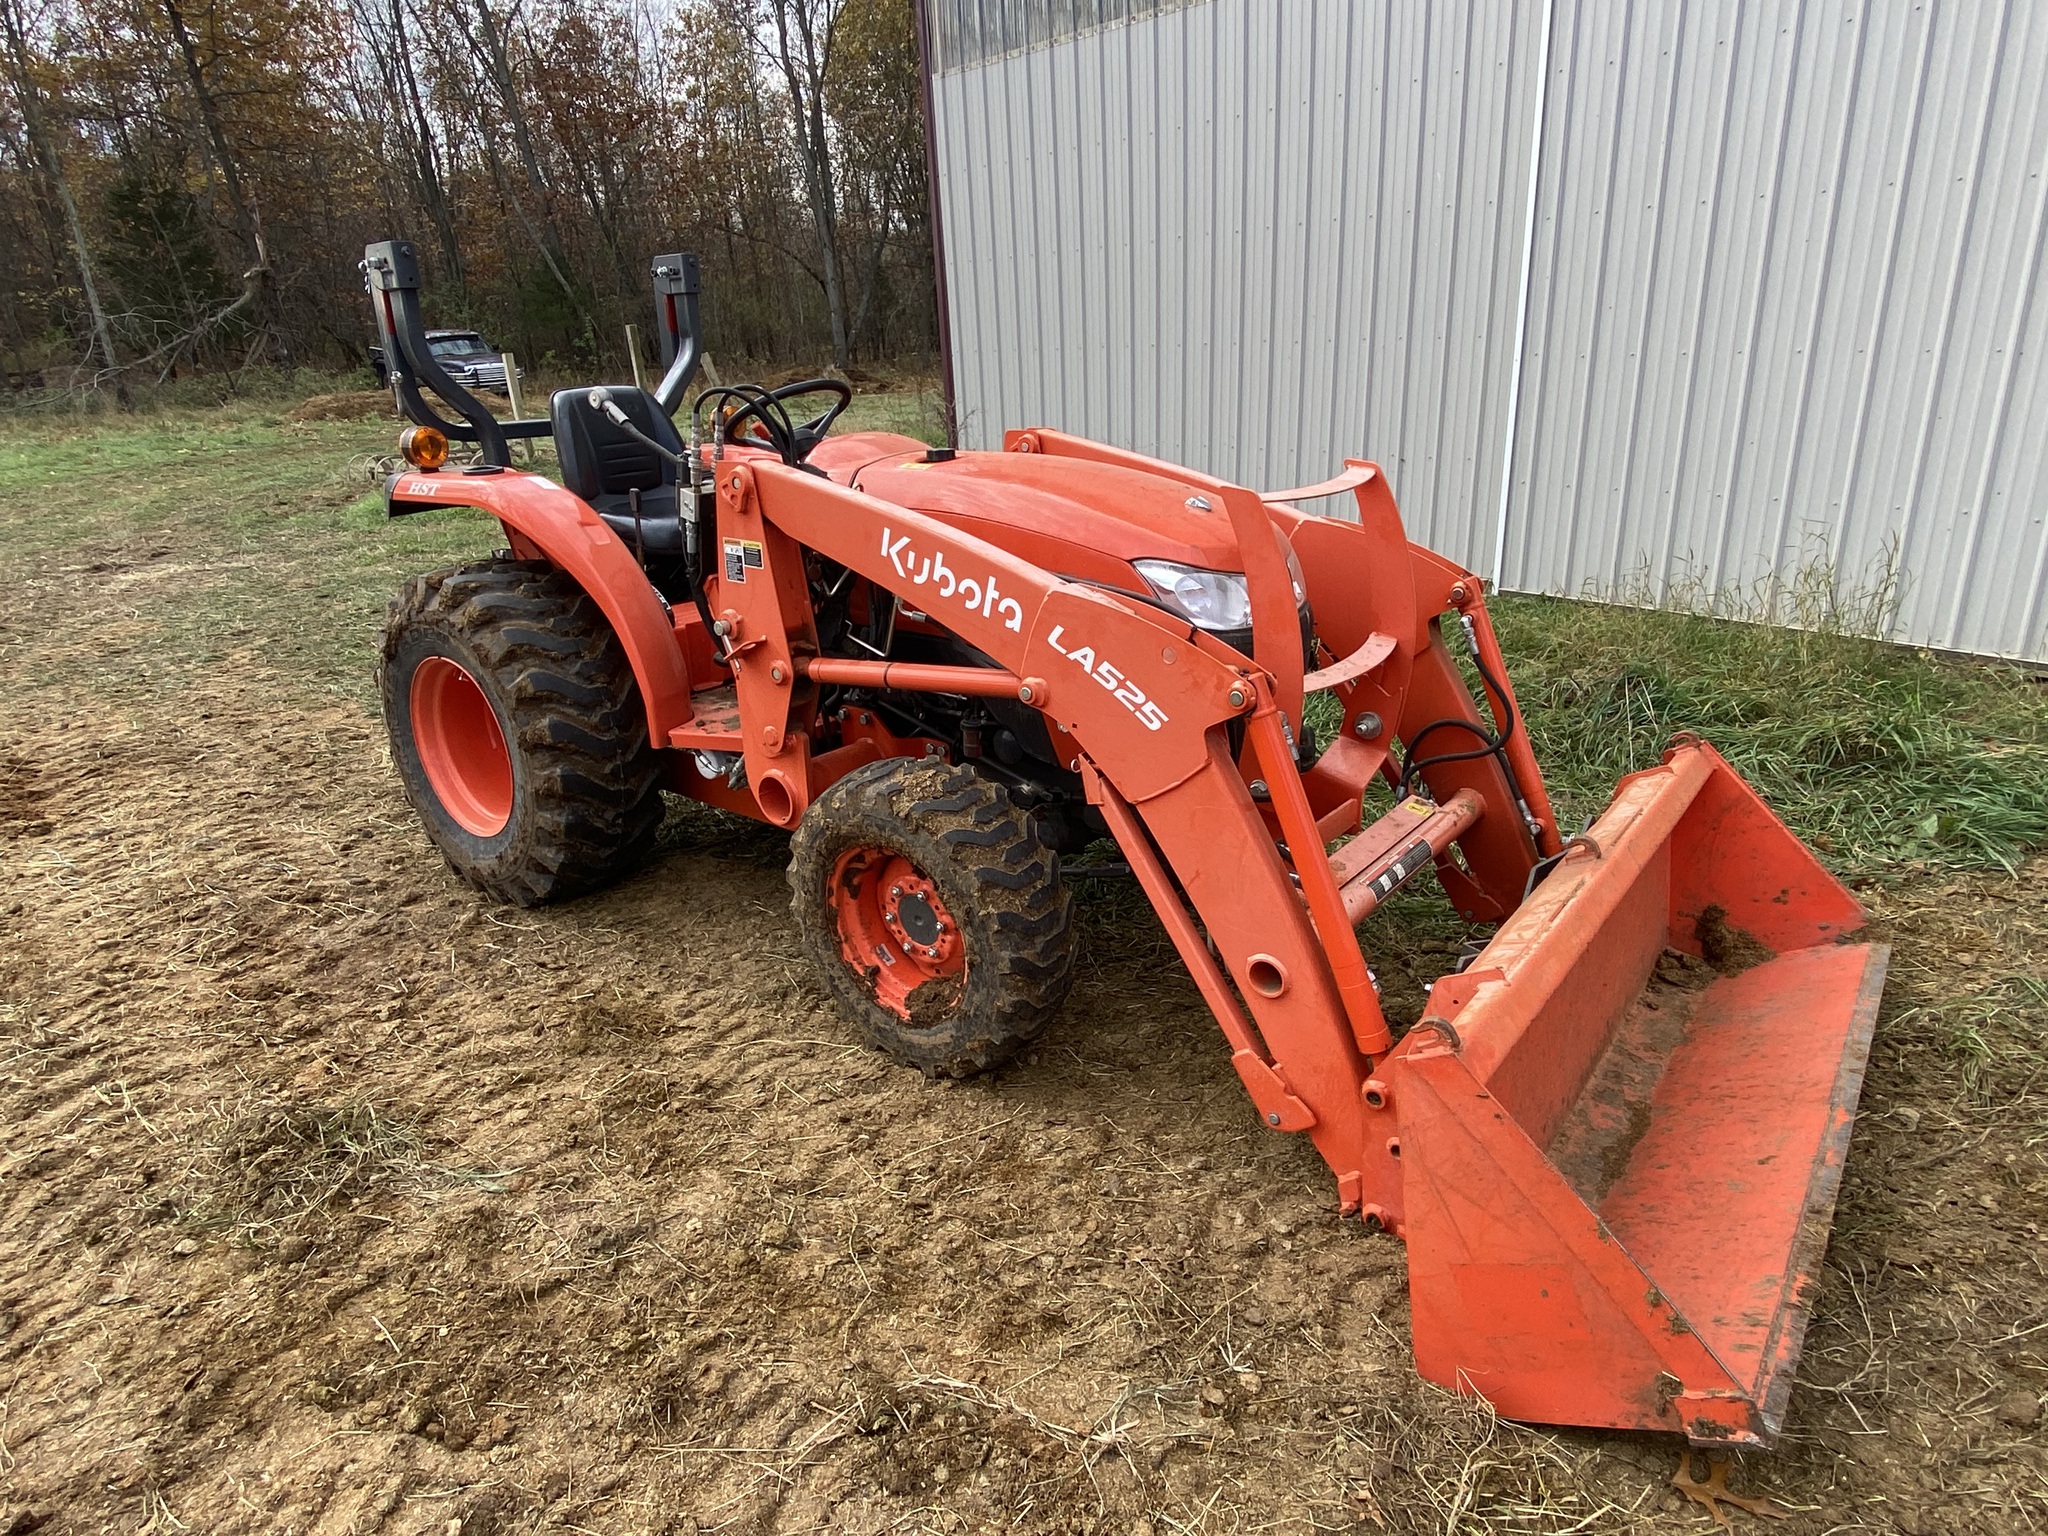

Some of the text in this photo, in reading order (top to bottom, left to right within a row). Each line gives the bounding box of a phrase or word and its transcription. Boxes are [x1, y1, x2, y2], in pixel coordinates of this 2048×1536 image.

[408, 482, 441, 496] HST
[880, 527, 1023, 633] Kubota
[1047, 624, 1170, 731] LA525
